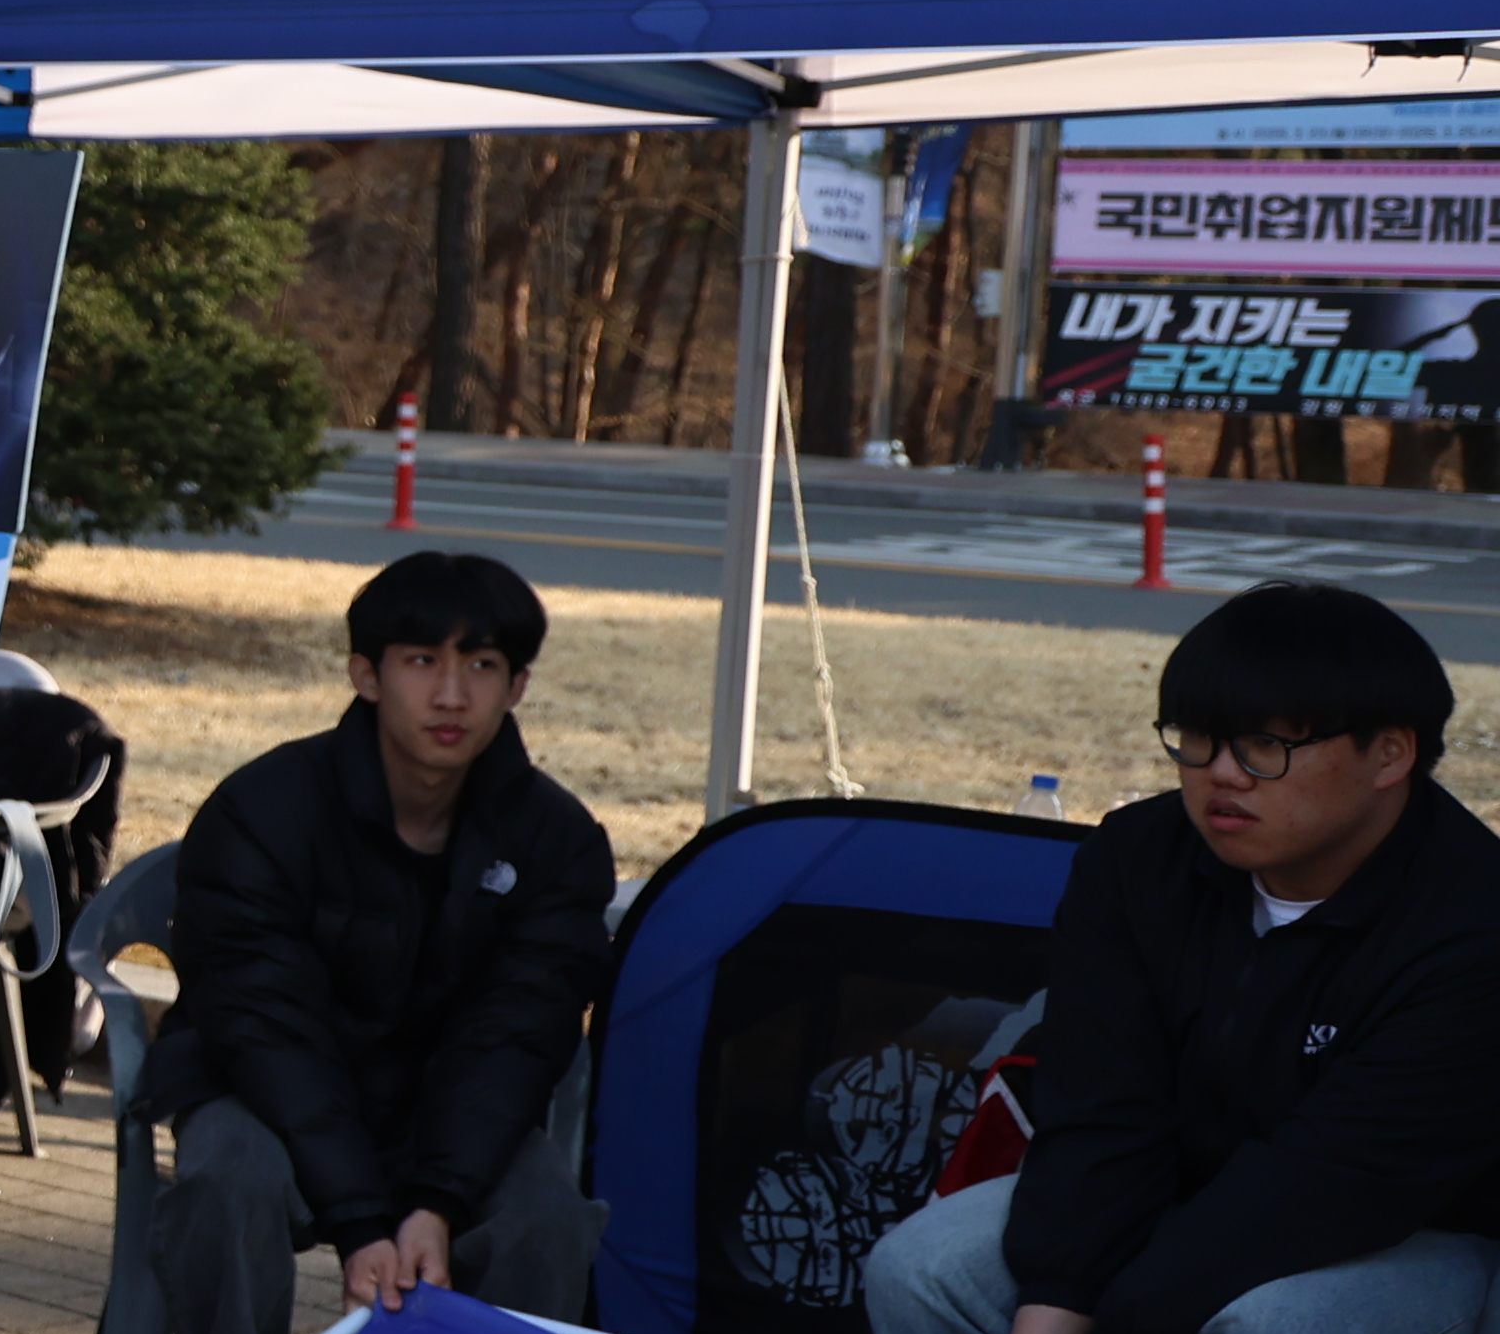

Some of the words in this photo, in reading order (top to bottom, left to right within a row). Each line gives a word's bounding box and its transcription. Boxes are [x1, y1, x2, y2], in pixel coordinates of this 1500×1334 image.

[1097, 191, 1500, 243] 국민취업지원제
[1060, 292, 1176, 340] 내가
[1178, 295, 1350, 347] 지키는
[1299, 349, 1426, 398] 내일
